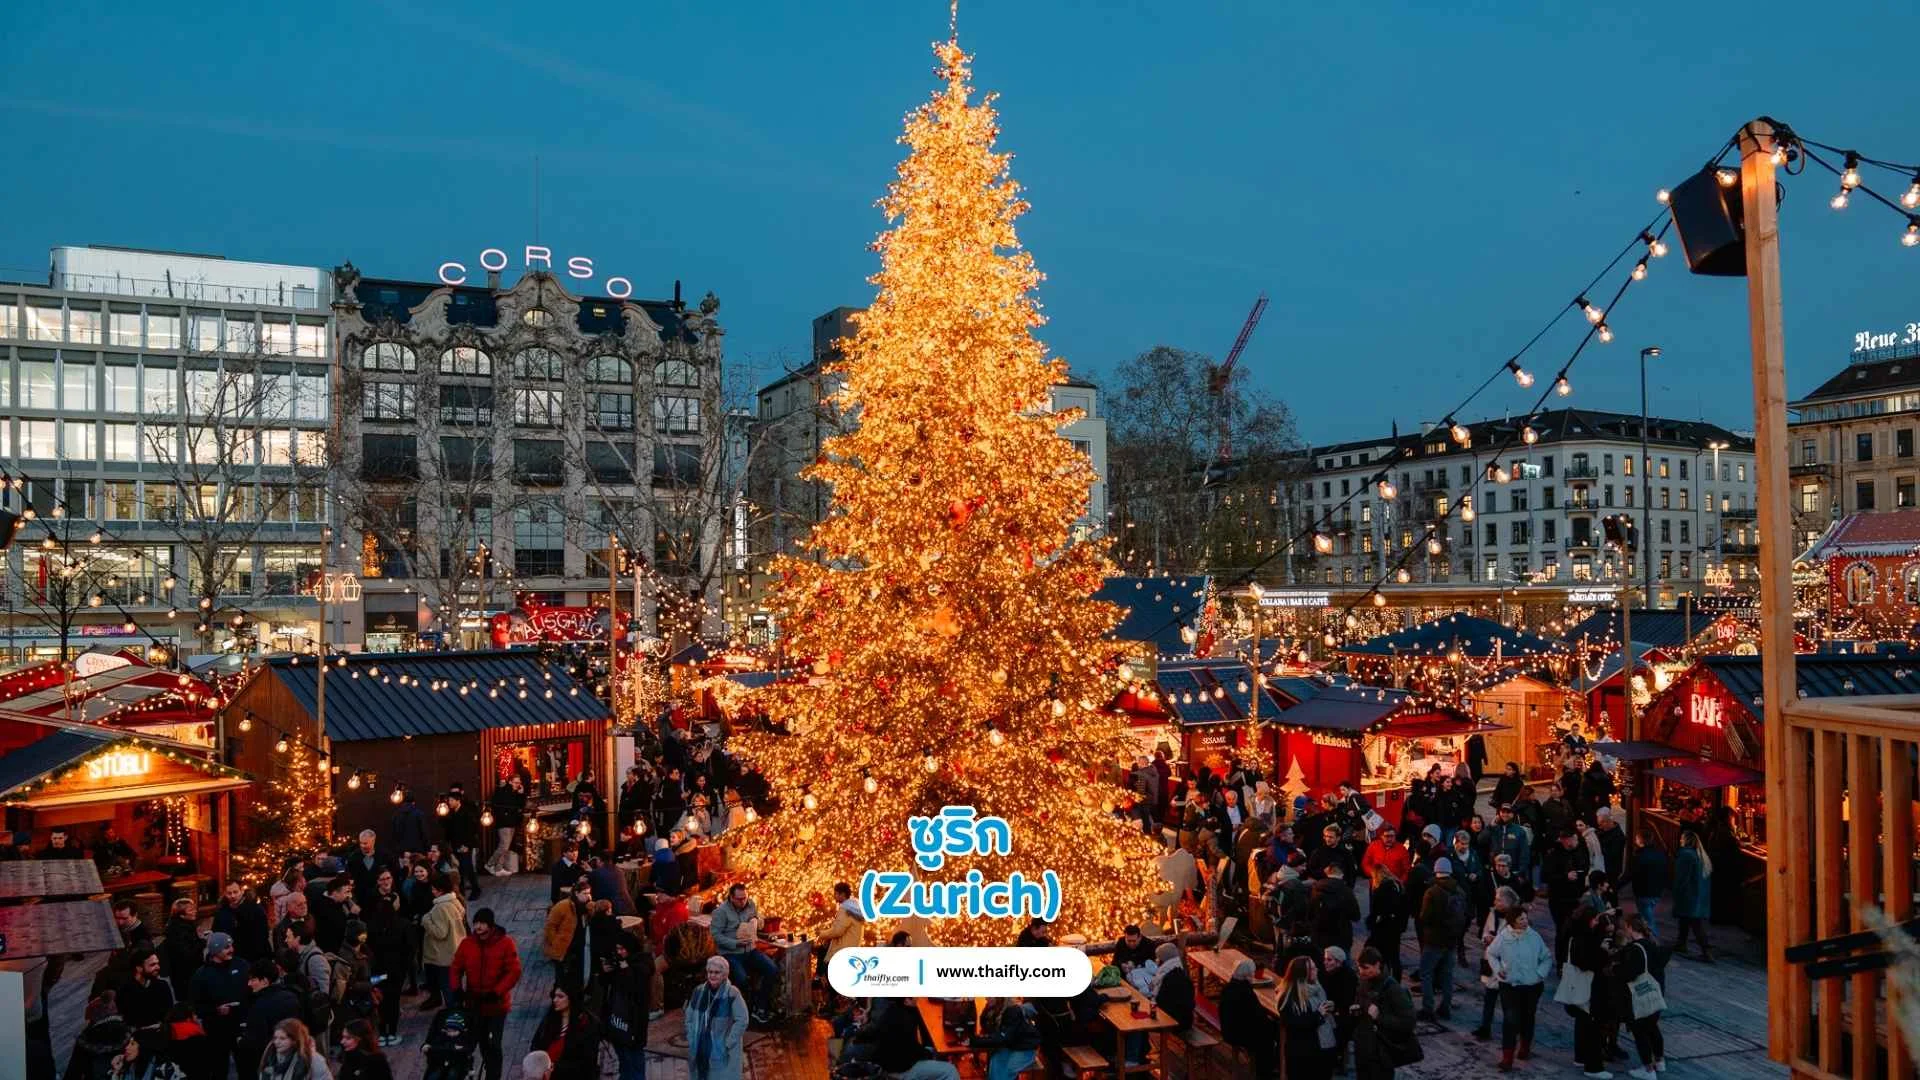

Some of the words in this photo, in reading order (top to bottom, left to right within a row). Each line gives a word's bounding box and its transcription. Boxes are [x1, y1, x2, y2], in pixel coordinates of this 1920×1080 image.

[438, 245, 633, 299] CORSO
[1854, 331, 1898, 352] Neue
[1717, 624, 1736, 638] BAR
[1691, 693, 1723, 729] BAR
